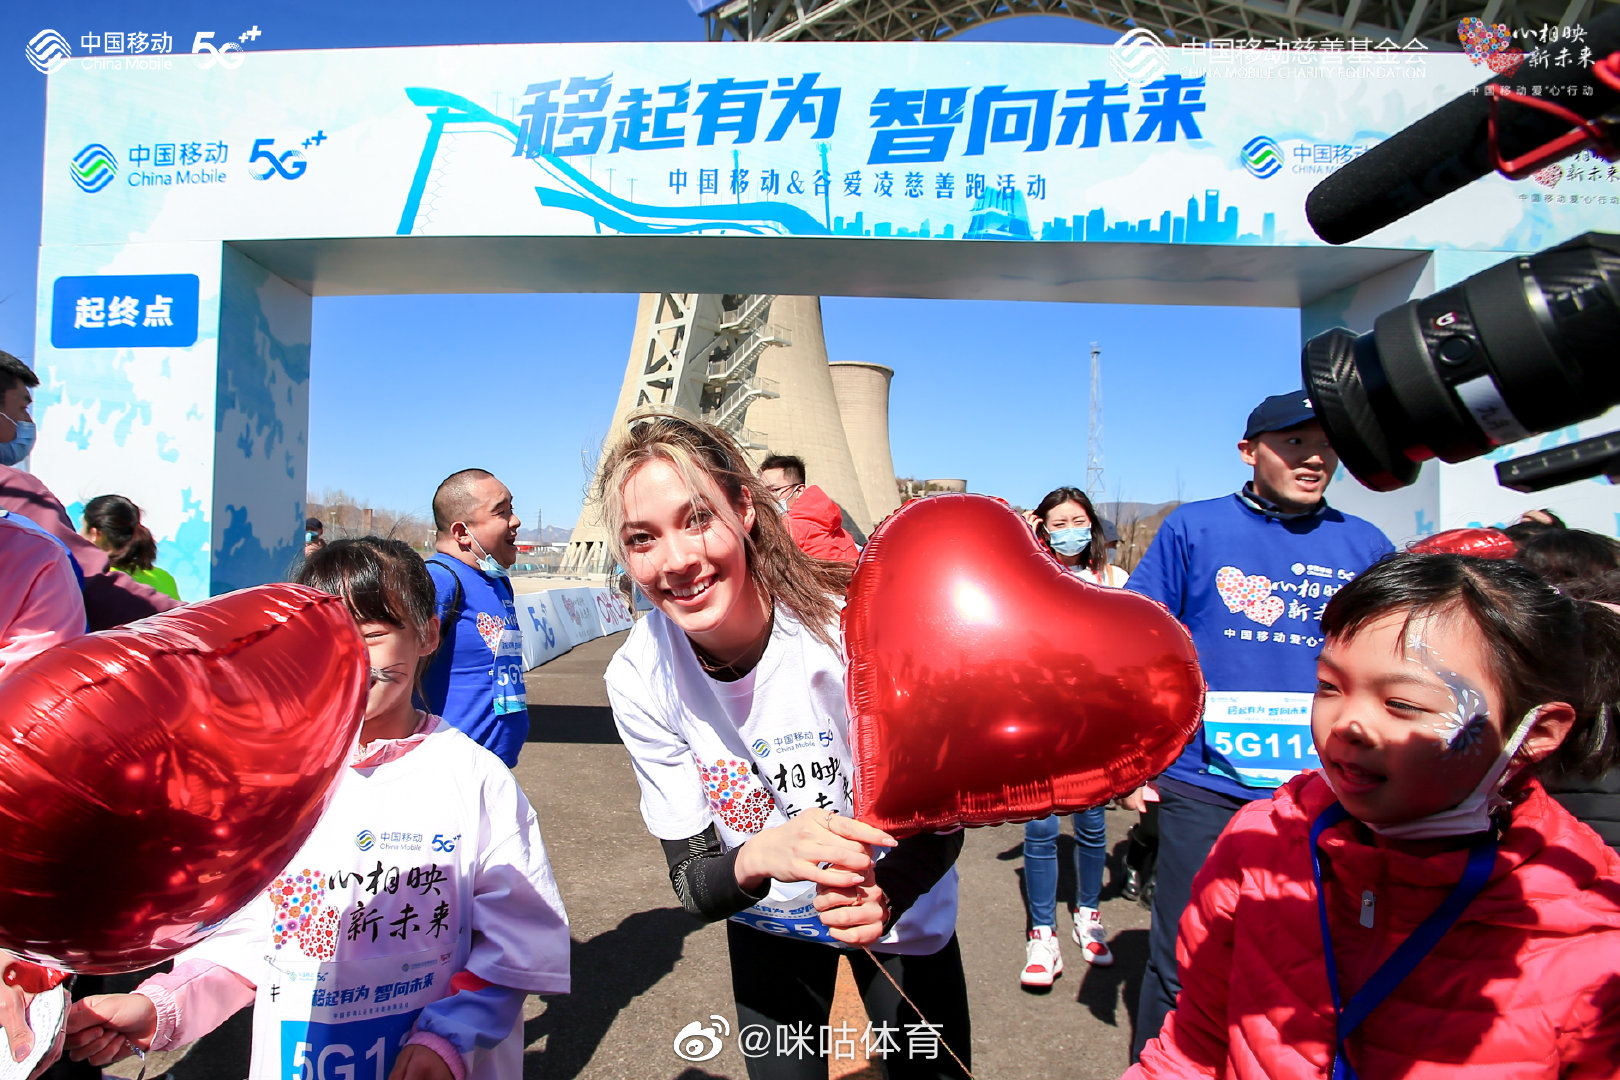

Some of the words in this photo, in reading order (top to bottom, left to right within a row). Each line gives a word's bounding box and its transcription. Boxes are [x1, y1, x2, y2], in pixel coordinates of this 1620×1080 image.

[511, 72, 842, 159] 移起有为
[866, 72, 1207, 165] 智向未来
[129, 140, 229, 168] 中国移动
[128, 171, 172, 187] China
[176, 168, 227, 184] Mobile
[668, 168, 1047, 201] 中国移动&谷爱凌慈善跑活动
[74, 294, 174, 329] 起终点
[773, 731, 813, 747] 中国移动
[380, 831, 423, 843] 中国移动
[328, 861, 448, 896] 心相映
[312, 985, 370, 1007] 移起有为
[374, 972, 435, 1003] 智向未来
